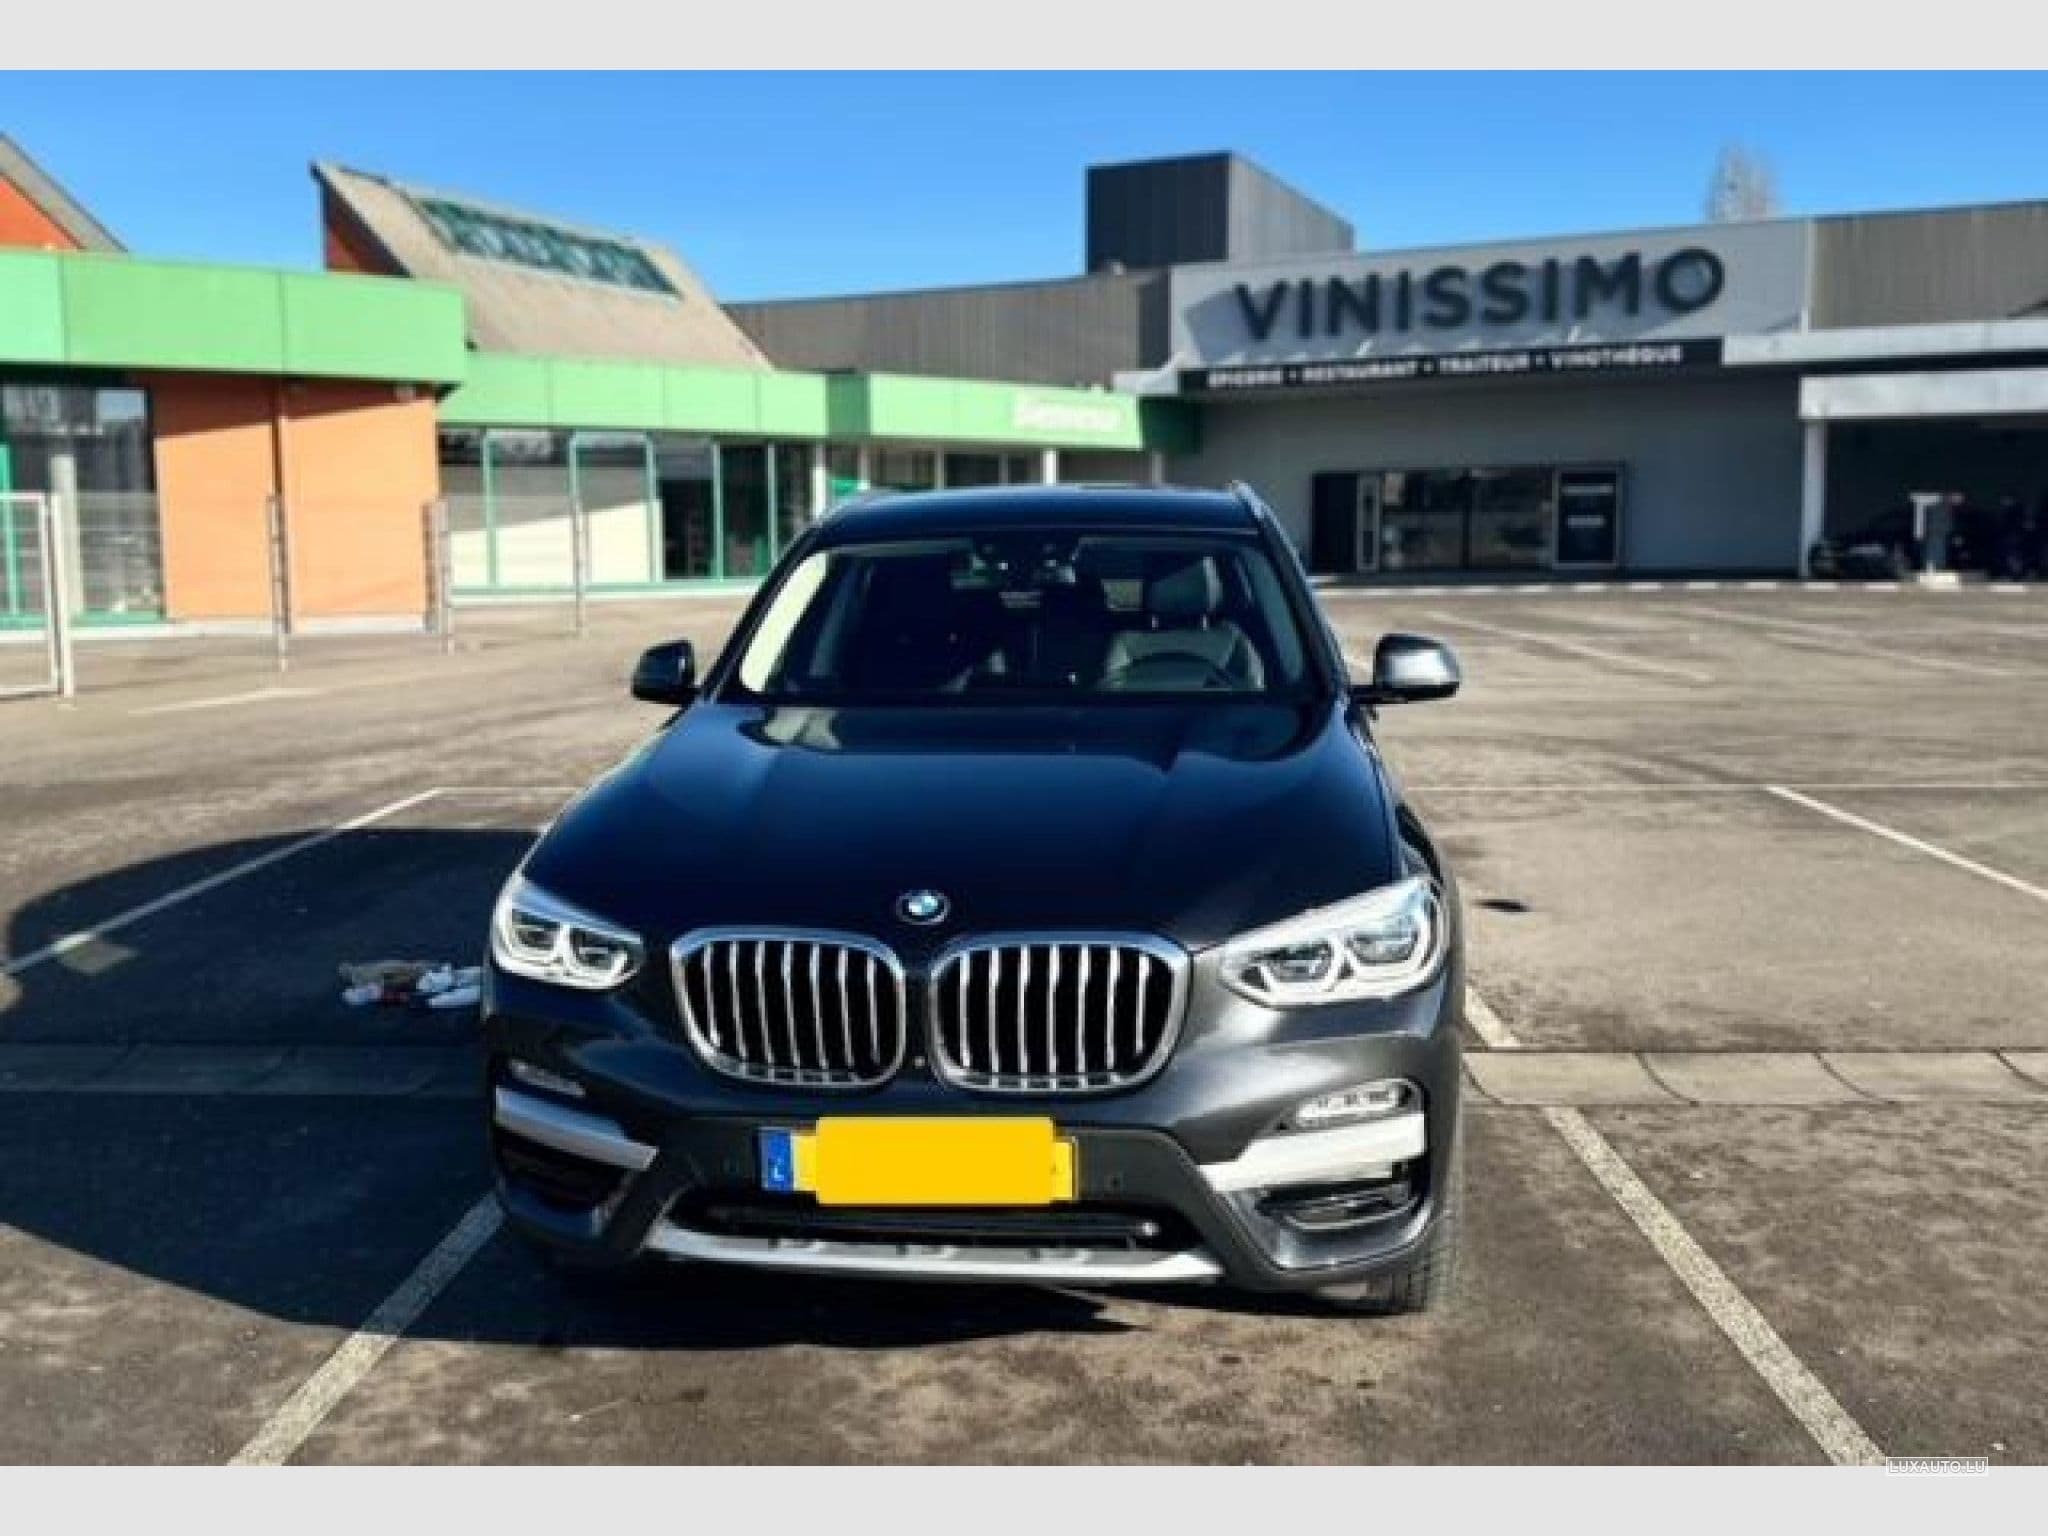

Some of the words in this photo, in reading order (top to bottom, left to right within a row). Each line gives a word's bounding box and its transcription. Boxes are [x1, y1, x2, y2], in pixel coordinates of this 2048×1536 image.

[1233, 248, 1724, 341] VINISSIMO
[1302, 360, 1418, 383] RESTAURANT
[1438, 353, 1530, 373] TRAITEUR
